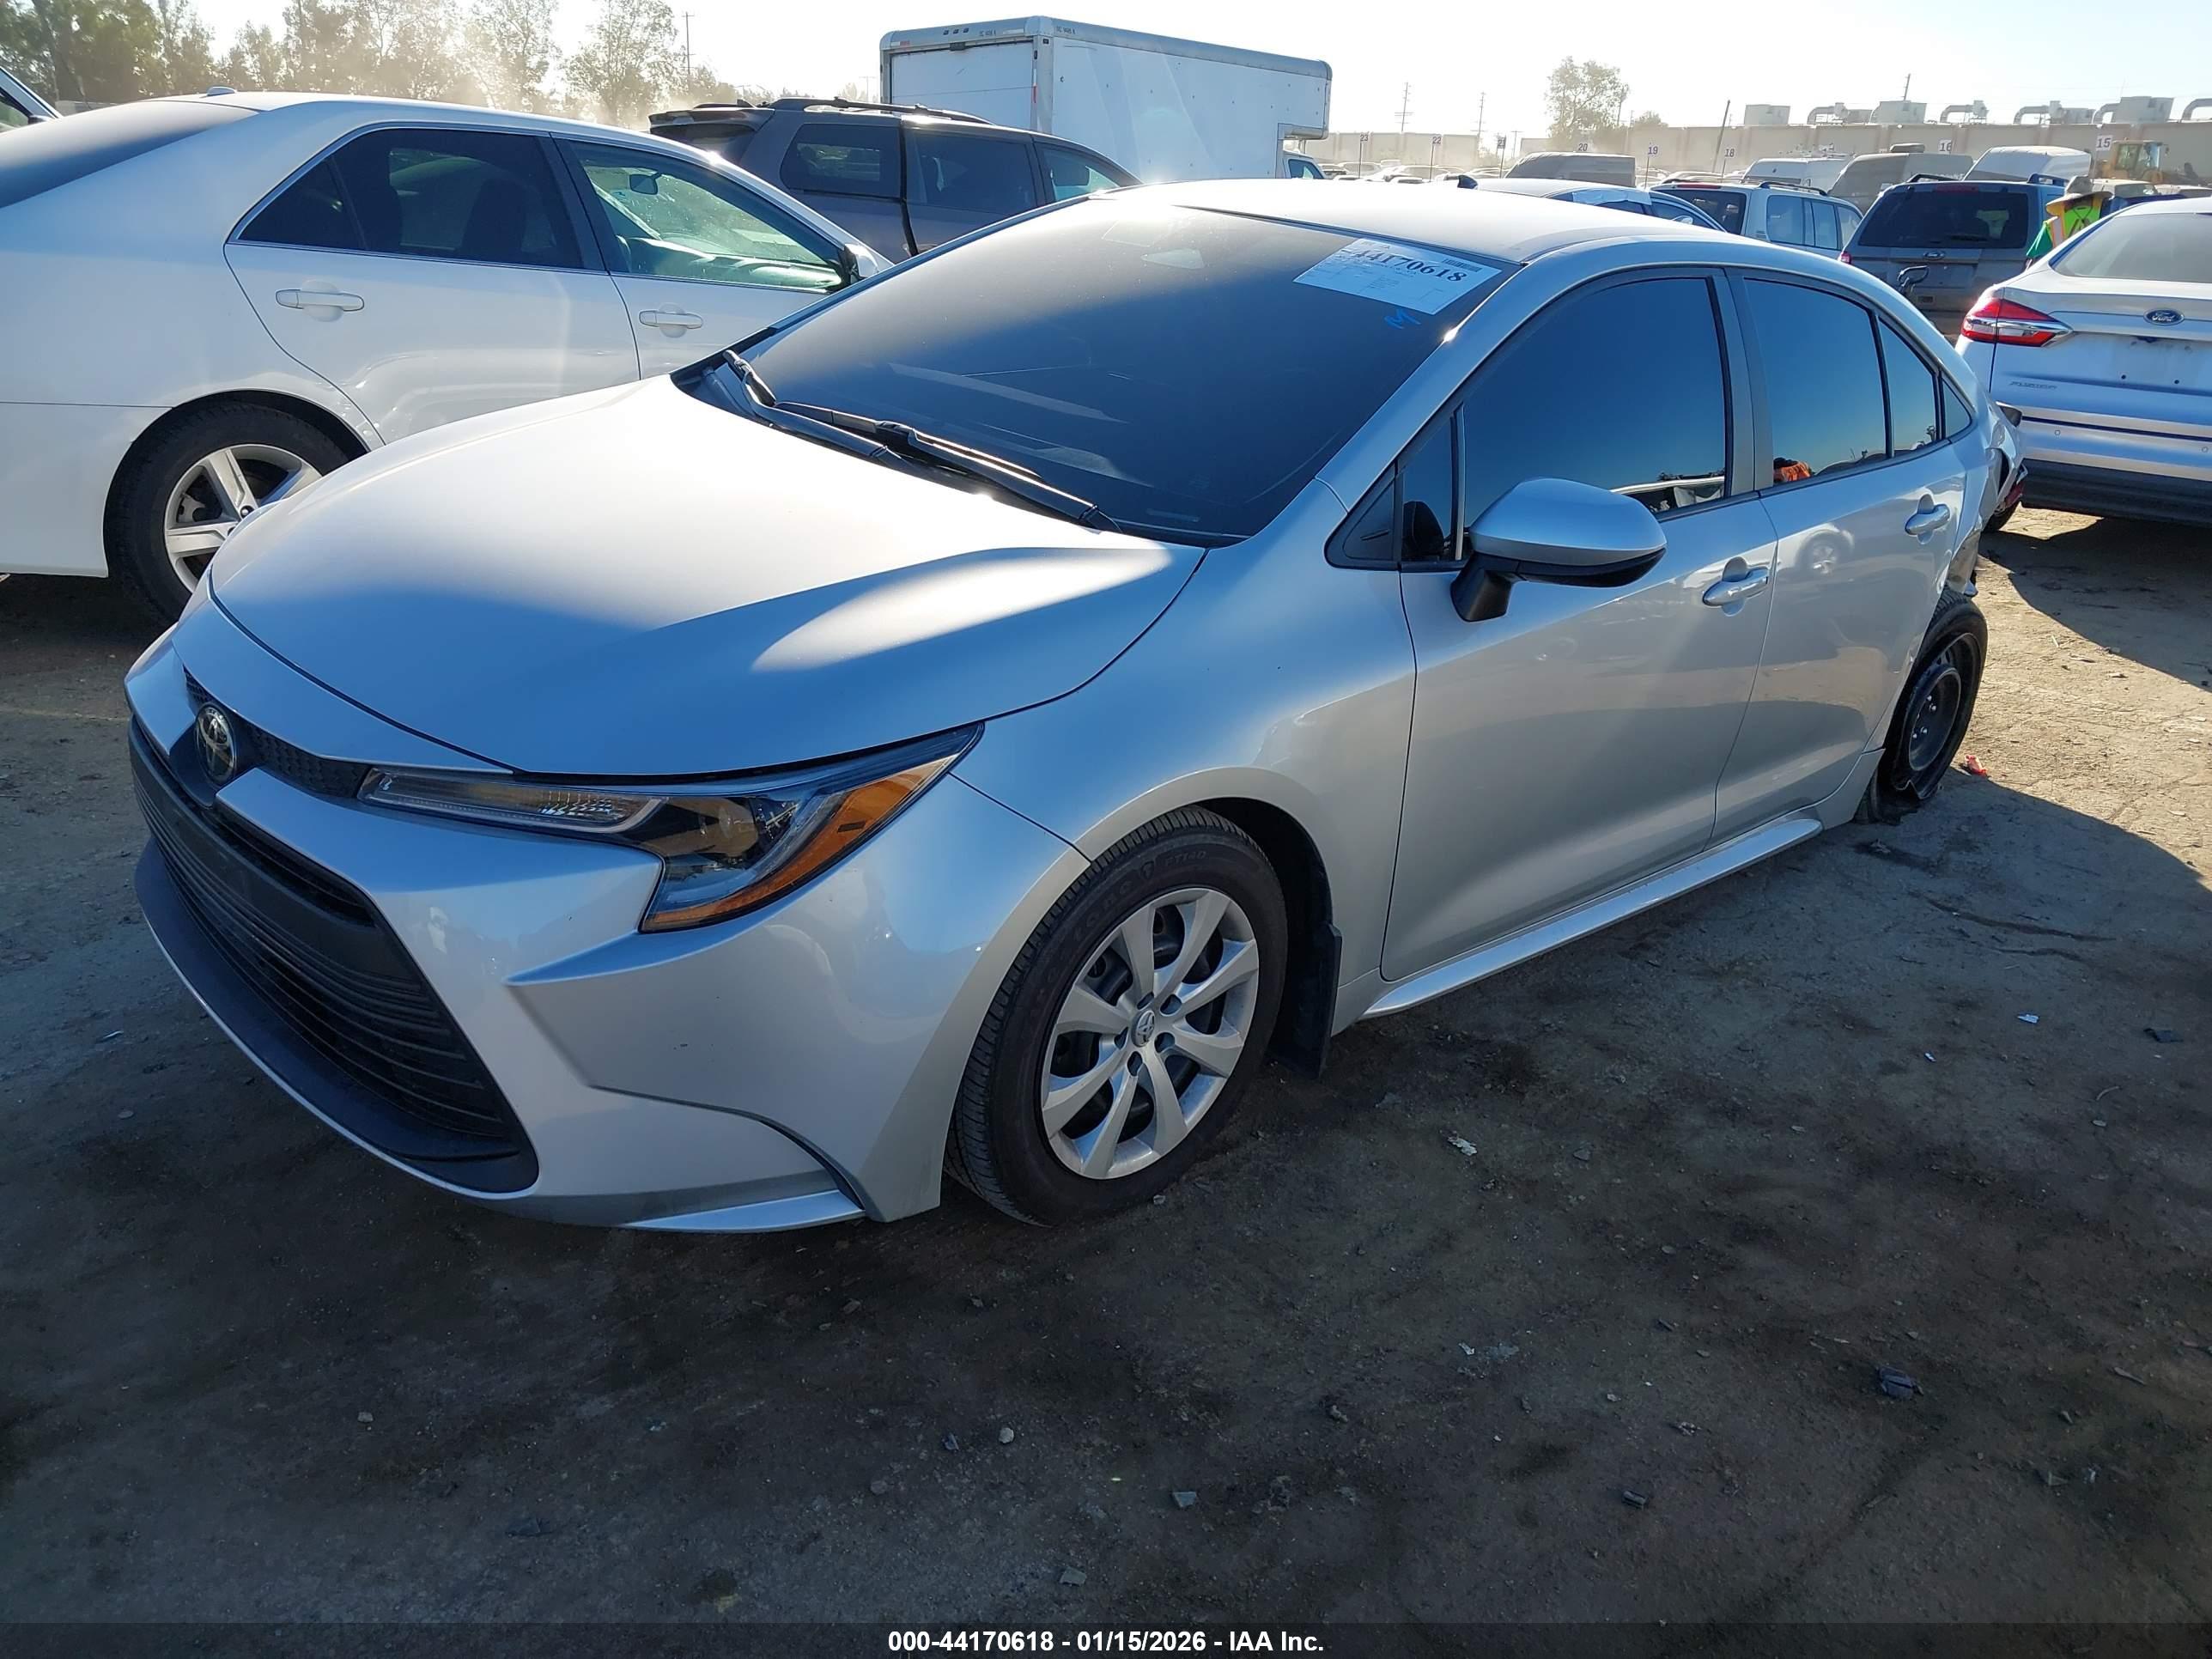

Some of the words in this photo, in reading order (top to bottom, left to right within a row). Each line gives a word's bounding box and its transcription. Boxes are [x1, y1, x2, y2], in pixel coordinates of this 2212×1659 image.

[1432, 136, 1442, 144] 22
[2095, 137, 2112, 148] 15
[1578, 143, 1589, 151] 20
[1648, 146, 1658, 155] 19
[1724, 149, 1735, 157] 18
[1354, 250, 1468, 282] 44170618
